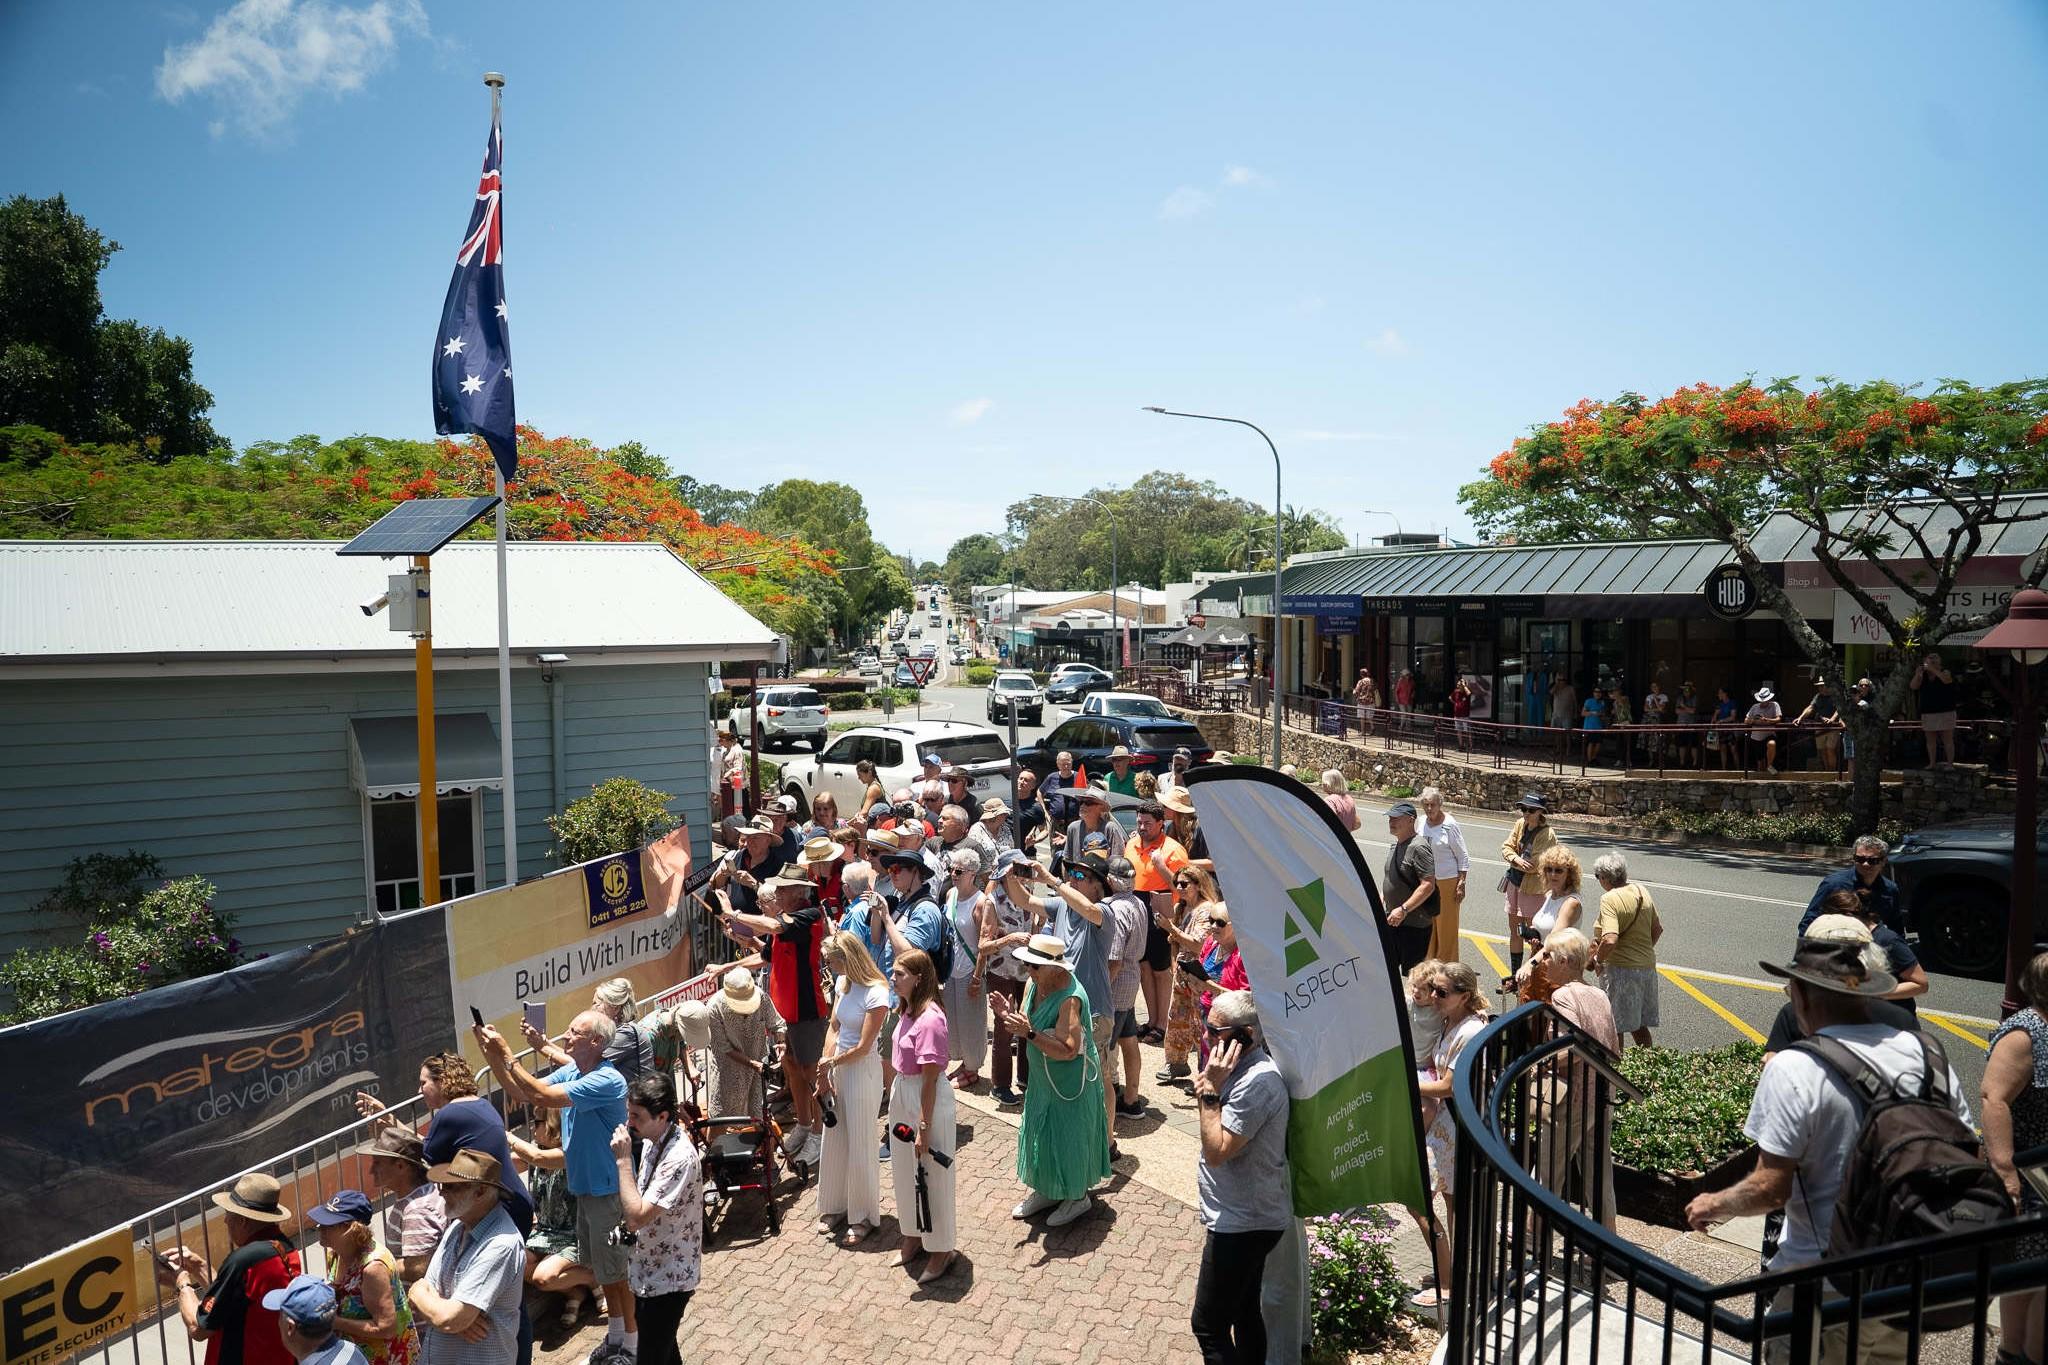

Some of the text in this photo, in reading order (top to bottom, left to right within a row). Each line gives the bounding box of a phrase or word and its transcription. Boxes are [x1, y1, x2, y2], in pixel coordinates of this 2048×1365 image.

[1718, 578, 1746, 607] HUB
[1787, 577, 1811, 589] Shop
[591, 899, 647, 924] 0411 182 229
[515, 953, 571, 1000] Build
[578, 936, 624, 976] With
[630, 914, 684, 957] Integy
[657, 979, 715, 1008] WARNING
[1284, 956, 1361, 1018] ASPECT
[197, 1040, 369, 1123] developments
[331, 1089, 353, 1112] PTY
[1326, 1090, 1373, 1129] Architects
[1346, 1118, 1355, 1132] &
[1333, 1130, 1371, 1160] Project
[1329, 1144, 1385, 1182] Managers
[3, 1255, 125, 1363] EC
[54, 1312, 126, 1356] SECURITY
